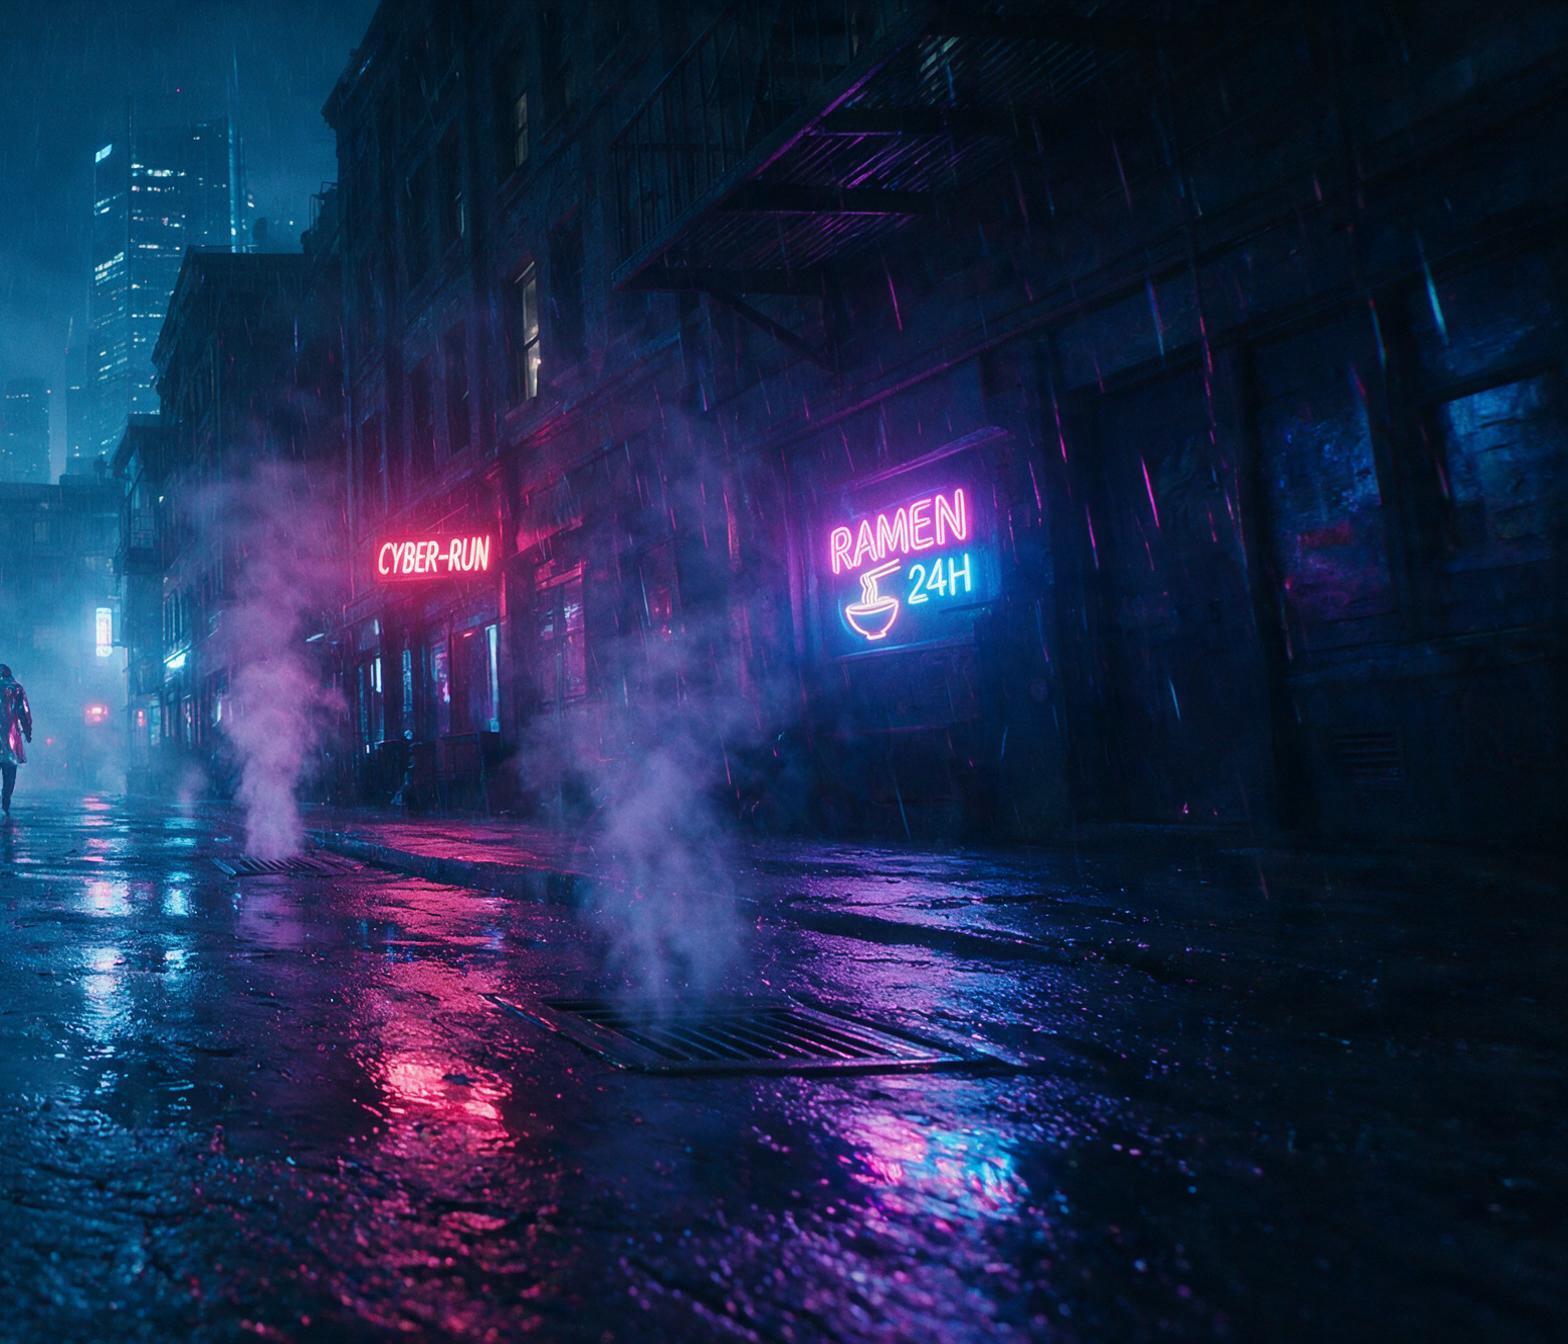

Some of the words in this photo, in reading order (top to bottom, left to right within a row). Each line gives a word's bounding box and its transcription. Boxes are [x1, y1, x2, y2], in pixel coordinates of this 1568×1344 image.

[378, 535, 490, 575] CYBER-RUN
[831, 488, 967, 574] RAMEN
[908, 553, 971, 604] 24H
